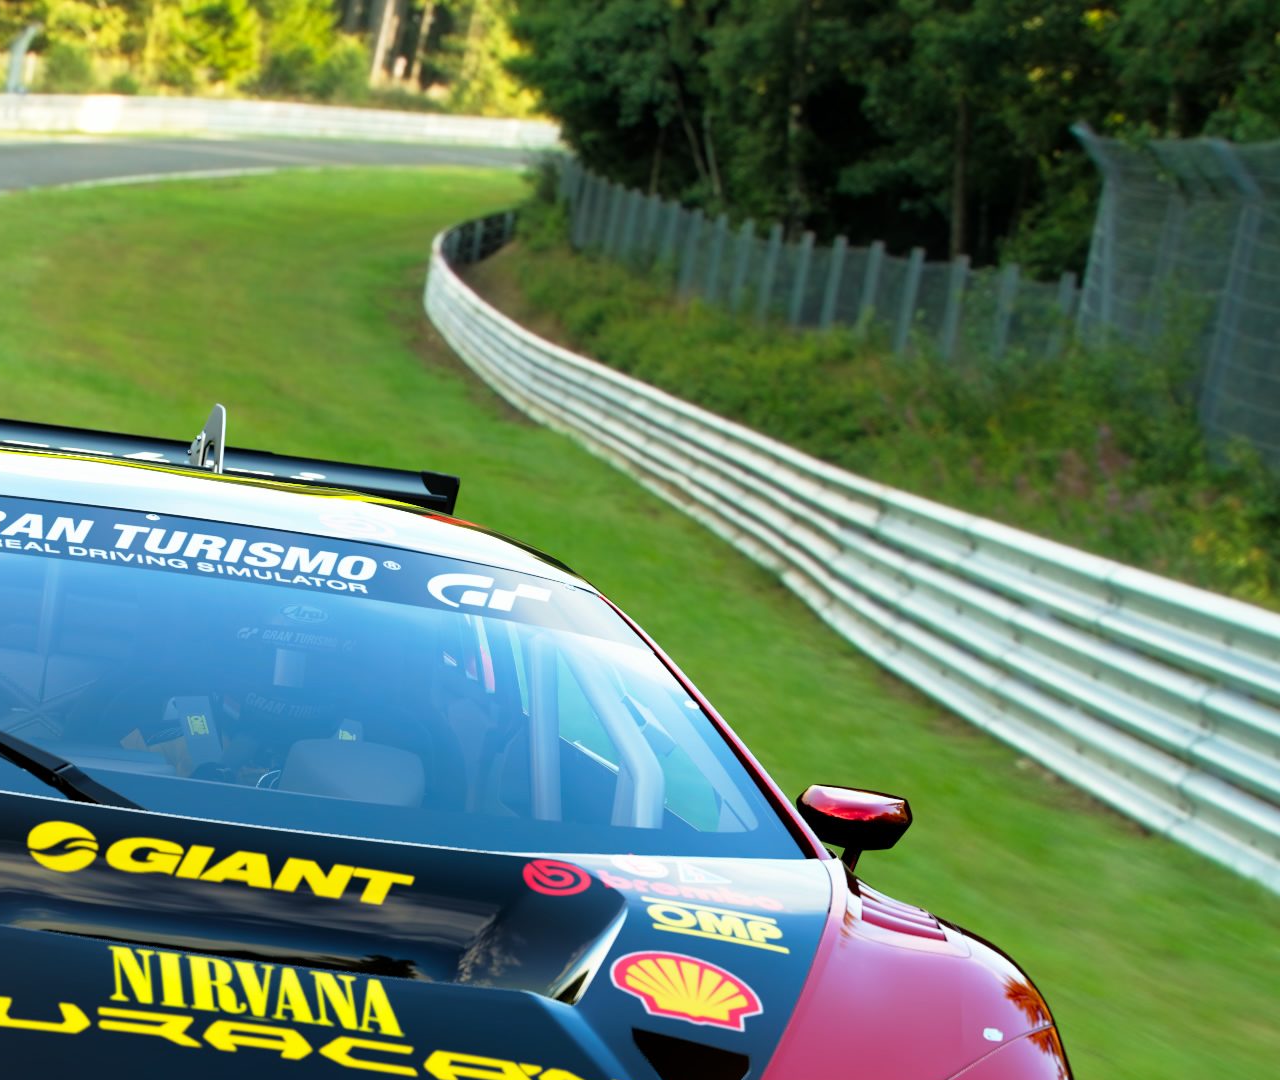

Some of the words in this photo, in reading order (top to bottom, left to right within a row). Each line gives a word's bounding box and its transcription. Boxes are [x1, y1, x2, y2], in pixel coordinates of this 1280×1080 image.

[68, 545, 189, 571] DRIVING
[196, 560, 369, 594] SIMULATOR
[262, 629, 293, 642] GRAN
[106, 837, 415, 905] GIANT
[595, 870, 785, 912] brembo
[646, 903, 784, 944] OMP
[108, 946, 404, 1037] NIRVANA
